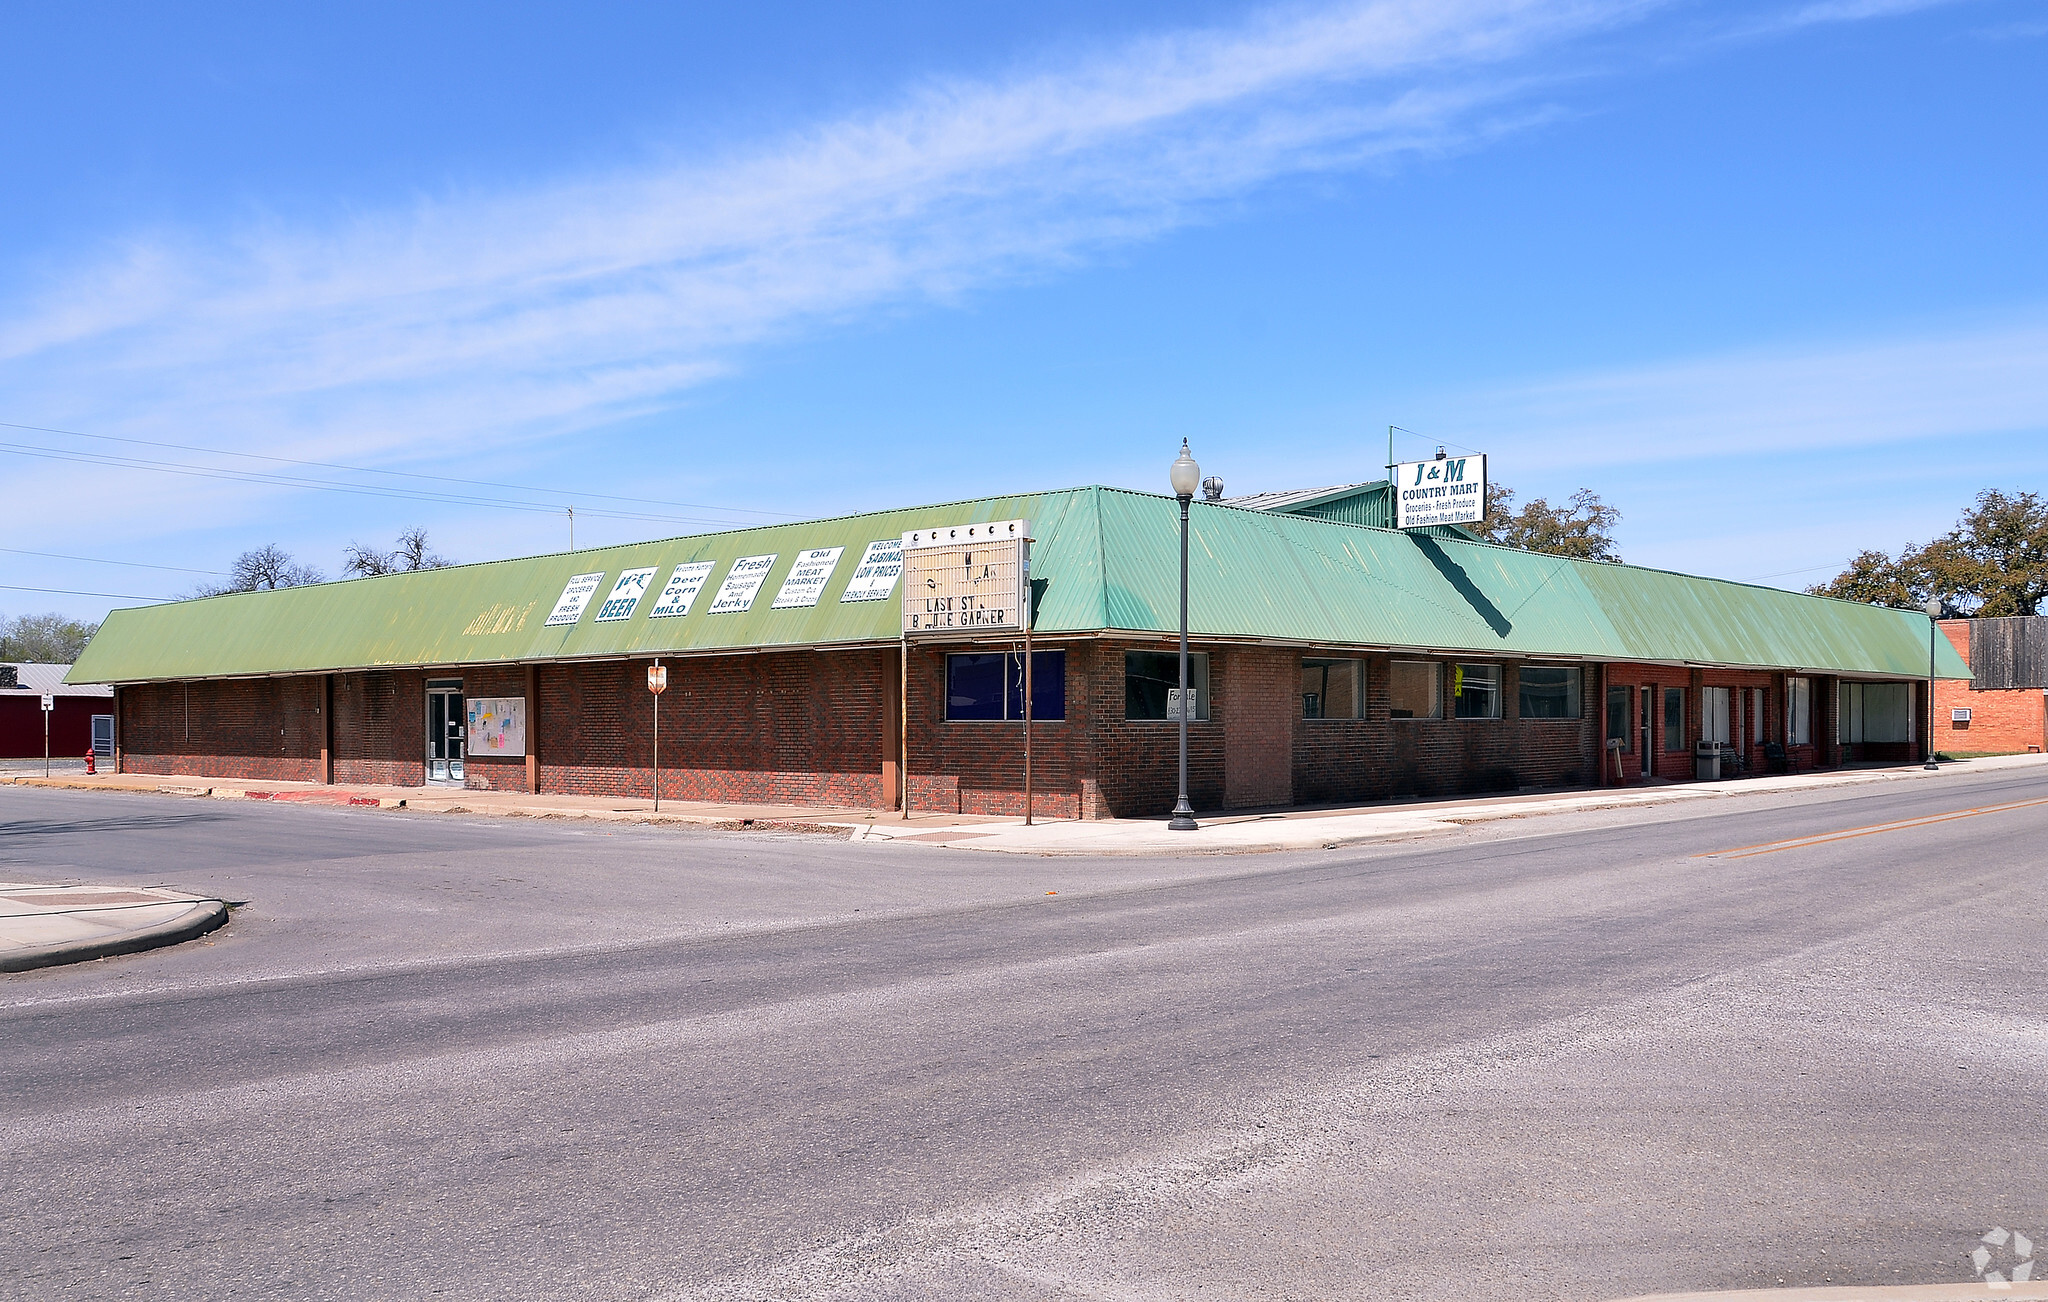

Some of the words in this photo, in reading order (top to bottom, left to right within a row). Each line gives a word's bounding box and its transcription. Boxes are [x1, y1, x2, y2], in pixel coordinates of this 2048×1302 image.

[1415, 463, 1425, 486] J
[1427, 466, 1440, 480] &
[1443, 459, 1466, 483] M
[1402, 485, 1447, 500] COUNTRY
[1450, 482, 1478, 496] MART
[1405, 502, 1431, 513] Groceries
[1436, 499, 1451, 511] Fresh
[1453, 498, 1475, 509] Produce
[1405, 515, 1415, 525] Old
[1416, 513, 1439, 525] Fashion
[1440, 511, 1453, 522] Meat
[1455, 510, 1475, 521] Market
[871, 541, 902, 550] WELCOME
[811, 550, 831, 558] Old
[866, 551, 902, 564] SABINAL
[734, 557, 771, 571] Fresh
[796, 559, 835, 568] Fashioned
[796, 568, 824, 576] MEAT
[856, 566, 874, 578] LOW
[872, 565, 901, 577] PRICES
[671, 576, 703, 584] Deer
[785, 577, 826, 585] MARKET
[725, 581, 756, 590] Sausage
[665, 587, 696, 595] Corn
[671, 595, 680, 603] &
[713, 598, 750, 608] Jerky
[599, 598, 636, 618] BEER
[926, 597, 953, 612] LAST
[961, 596, 975, 610] ST
[558, 605, 580, 613] FRESH
[653, 605, 686, 614] MILO
[549, 613, 579, 622] PRODUCE
[1169, 690, 1180, 701] For
